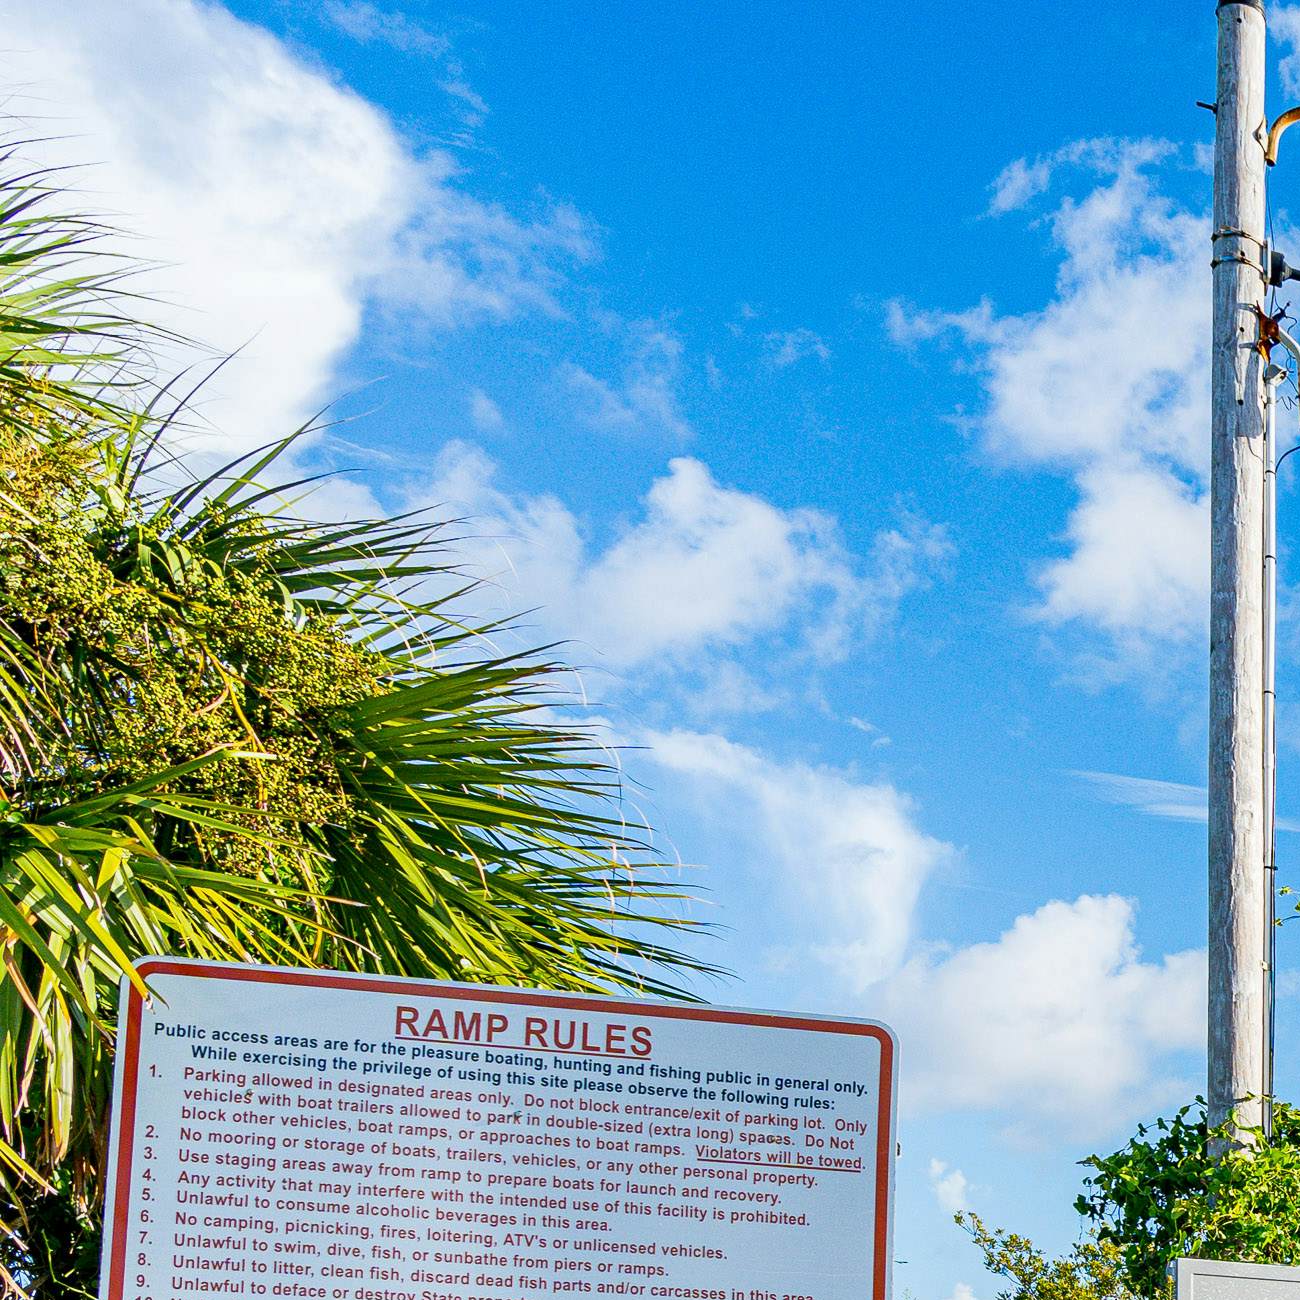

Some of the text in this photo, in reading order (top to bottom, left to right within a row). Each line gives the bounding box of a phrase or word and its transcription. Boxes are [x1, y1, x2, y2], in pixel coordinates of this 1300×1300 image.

[154, 1022, 867, 1097] Public access areas are for the pleasure boating, hunting and fishing public in general only.
[394, 1004, 652, 1056] RAMP RULES
[149, 1064, 867, 1136] 1. Parking allowed in designated areas only. Do not block entrance/exit of parking lot. Only
